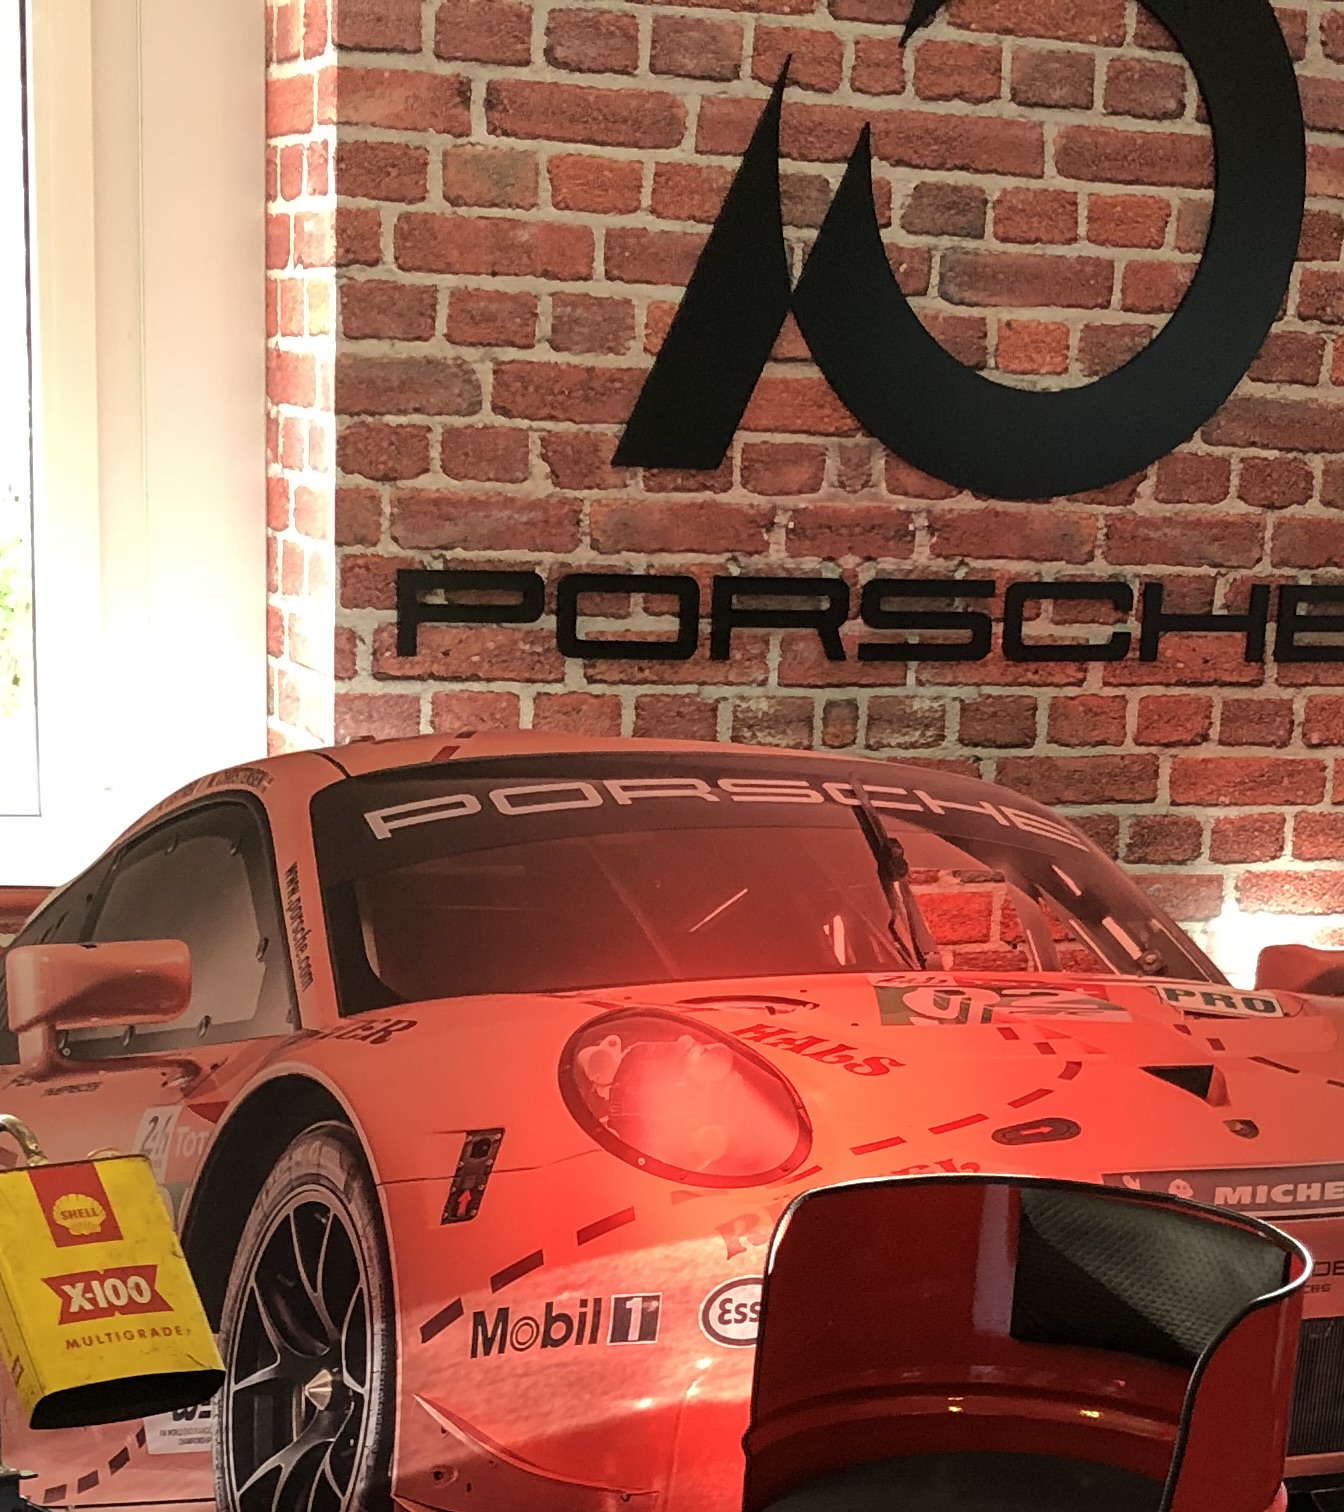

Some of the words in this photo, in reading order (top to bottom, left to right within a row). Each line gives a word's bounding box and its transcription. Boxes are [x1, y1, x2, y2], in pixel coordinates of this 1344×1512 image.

[363, 777, 1090, 852] PORSCHE
[1163, 986, 1277, 1014] PRO
[728, 1023, 906, 1077] HALS
[177, 1126, 211, 1158] TOT
[59, 1206, 99, 1221] SHELL
[61, 1275, 152, 1313] X-100
[717, 1297, 761, 1325] Ess
[65, 1324, 184, 1350] MULTIGRADE
[470, 1297, 602, 1360] Mobil
